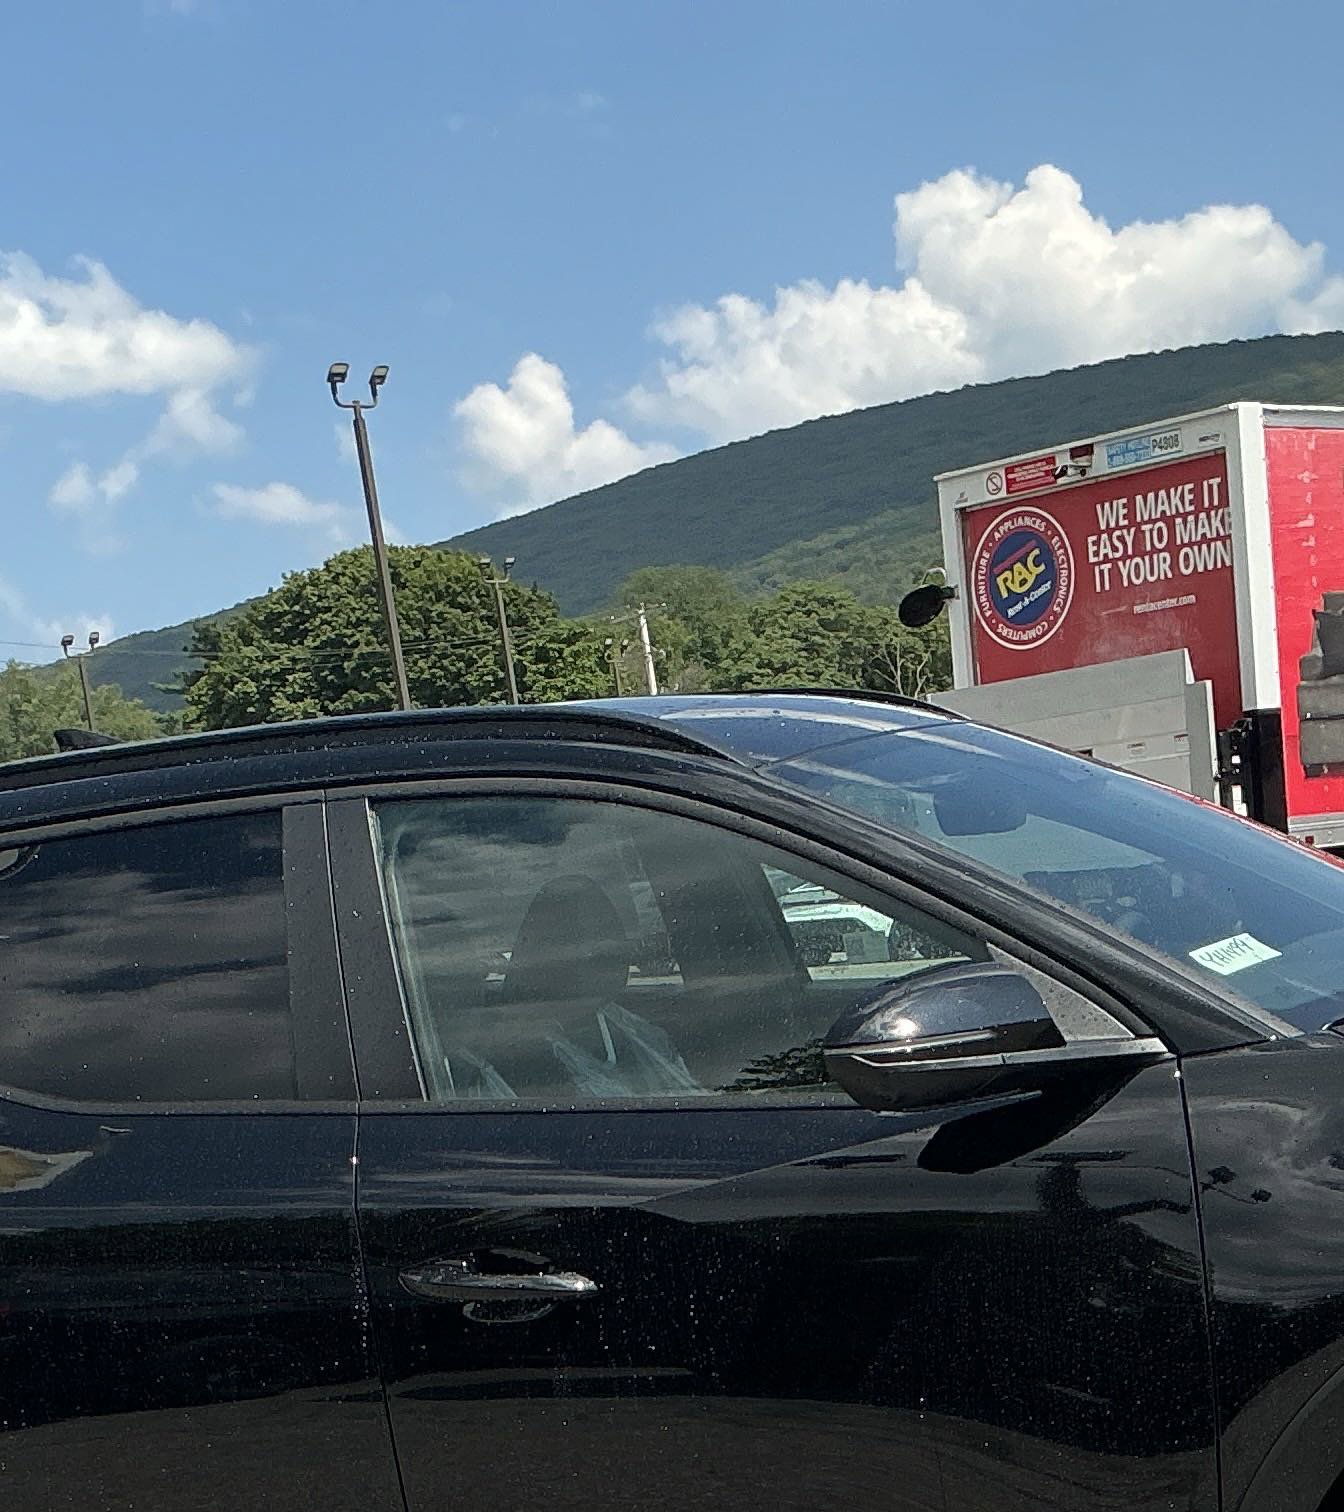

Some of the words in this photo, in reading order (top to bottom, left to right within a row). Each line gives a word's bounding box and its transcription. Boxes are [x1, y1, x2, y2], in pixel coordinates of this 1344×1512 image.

[993, 516, 1048, 541] APPLIANCES
[1096, 498, 1129, 530] WE
[1135, 483, 1195, 523] MAKE
[1203, 477, 1222, 508] IT
[1087, 527, 1136, 563] EASY
[1141, 521, 1168, 551] TO
[1174, 507, 1232, 545] MAKE
[977, 550, 992, 617] FURNITURE
[996, 548, 1046, 600] RAC
[1051, 535, 1069, 613] ELECTRONICS
[1094, 562, 1113, 592] IT
[1118, 552, 1173, 587] YOUR
[1178, 539, 1232, 576] OWN
[997, 620, 1049, 641] COMPUTERS
